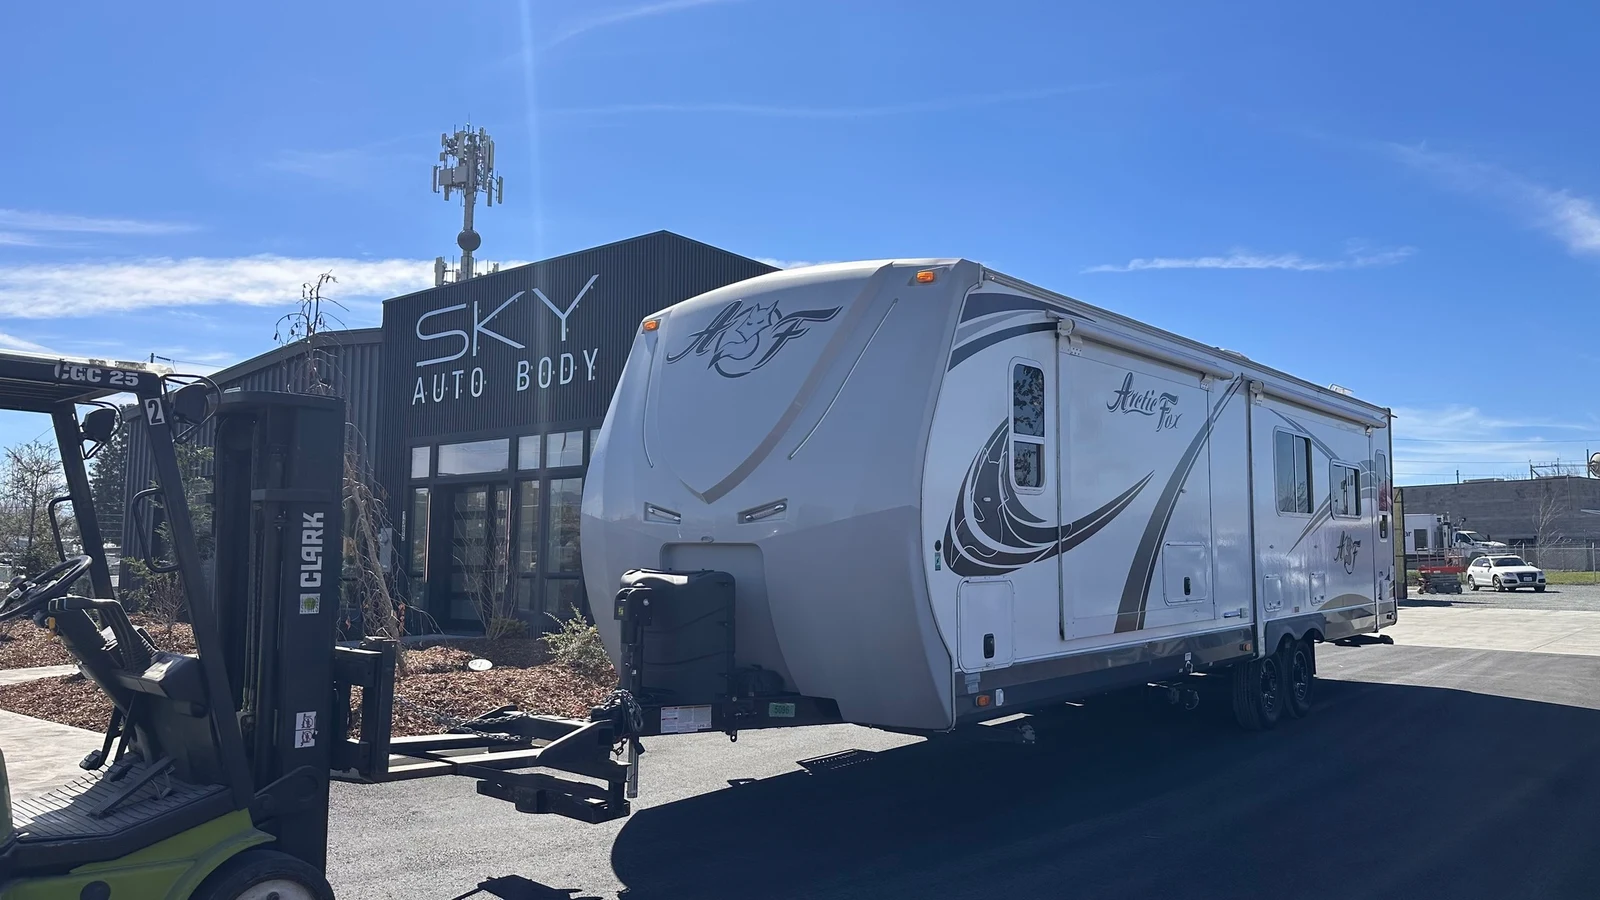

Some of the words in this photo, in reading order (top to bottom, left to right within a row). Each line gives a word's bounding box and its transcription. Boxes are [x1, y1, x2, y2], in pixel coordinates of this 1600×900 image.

[416, 274, 599, 367] SKY
[109, 370, 139, 386] 25
[412, 367, 484, 405] AUTO
[516, 348, 598, 391] BODY
[1106, 372, 1158, 415] Arctic
[1156, 392, 1183, 432] Fox
[147, 400, 162, 424] 2
[300, 512, 324, 588] CLARK
